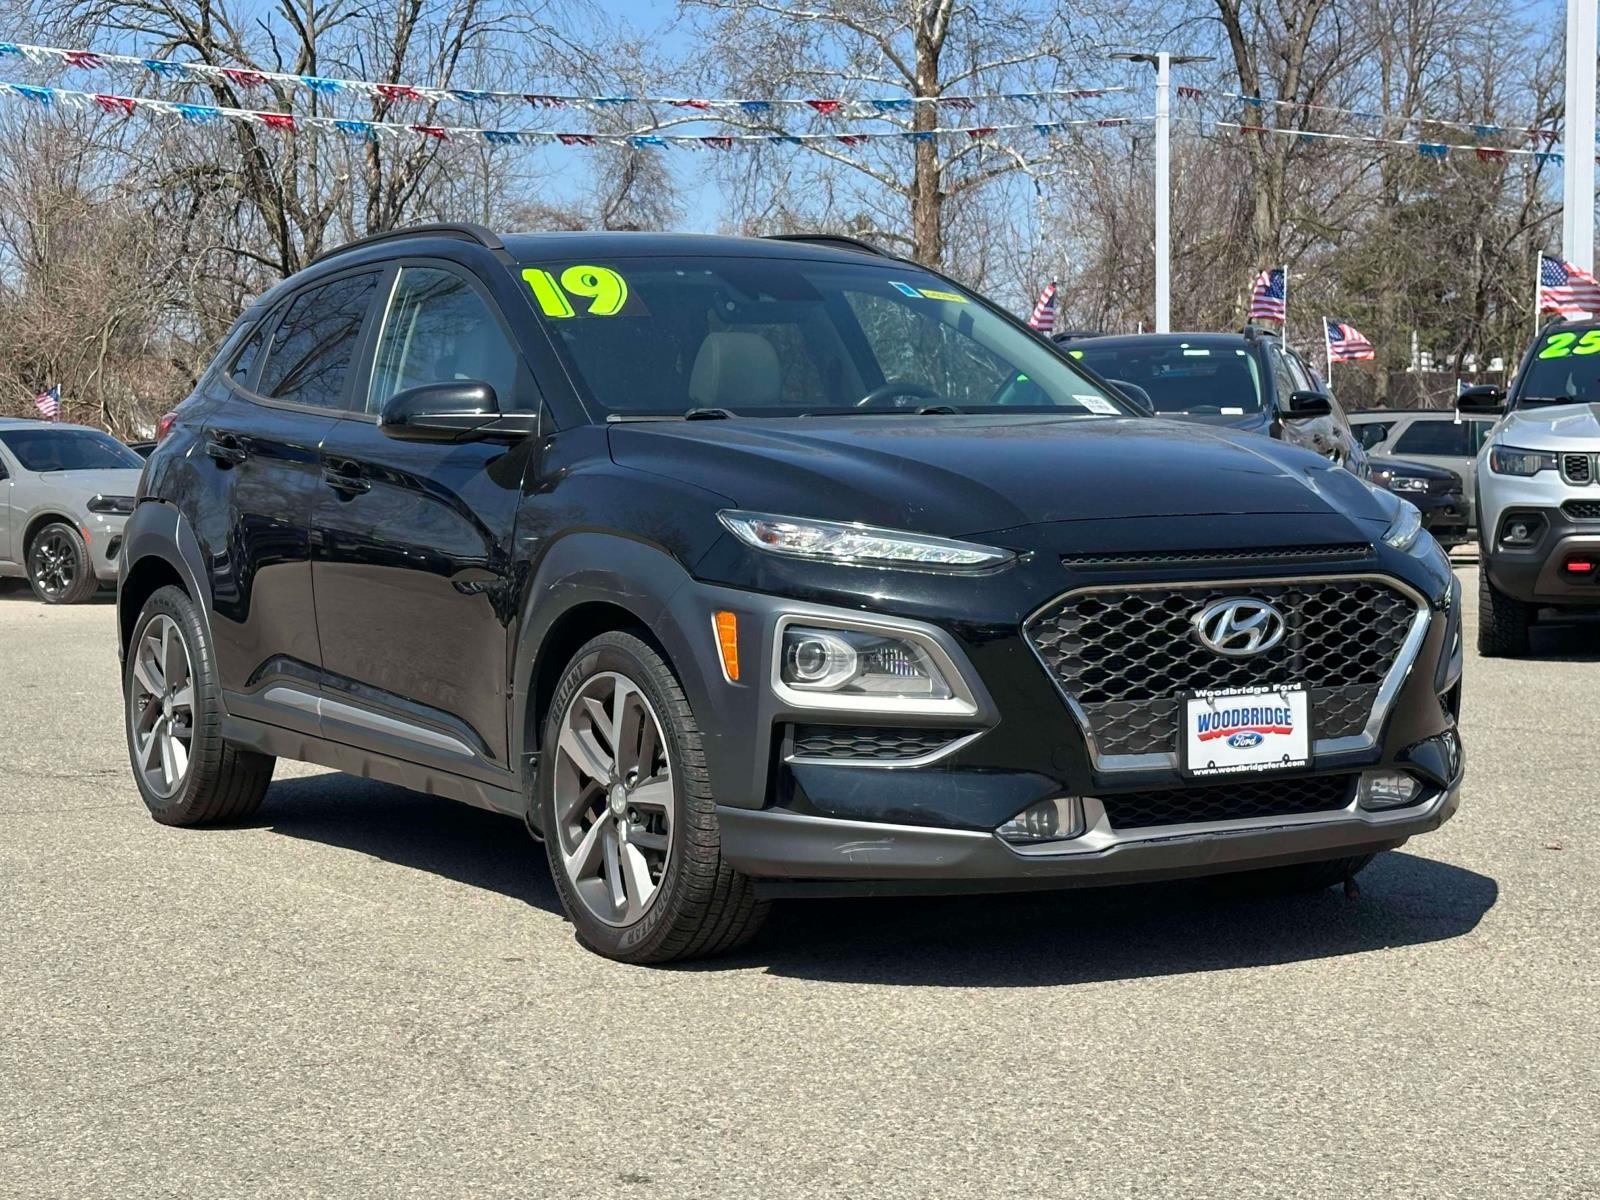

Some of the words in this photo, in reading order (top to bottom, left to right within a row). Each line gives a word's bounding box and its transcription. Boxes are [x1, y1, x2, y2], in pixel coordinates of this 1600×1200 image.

[521, 265, 628, 318] 19
[1538, 330, 1600, 359] 25
[551, 662, 584, 726] RELIANT
[1195, 685, 1269, 698] Woodbridge
[1272, 682, 1301, 692] Ford
[1198, 707, 1292, 733] WOODBRIDGE
[1233, 733, 1257, 747] Ford
[1193, 760, 1306, 776] www.woodbridgeford.com
